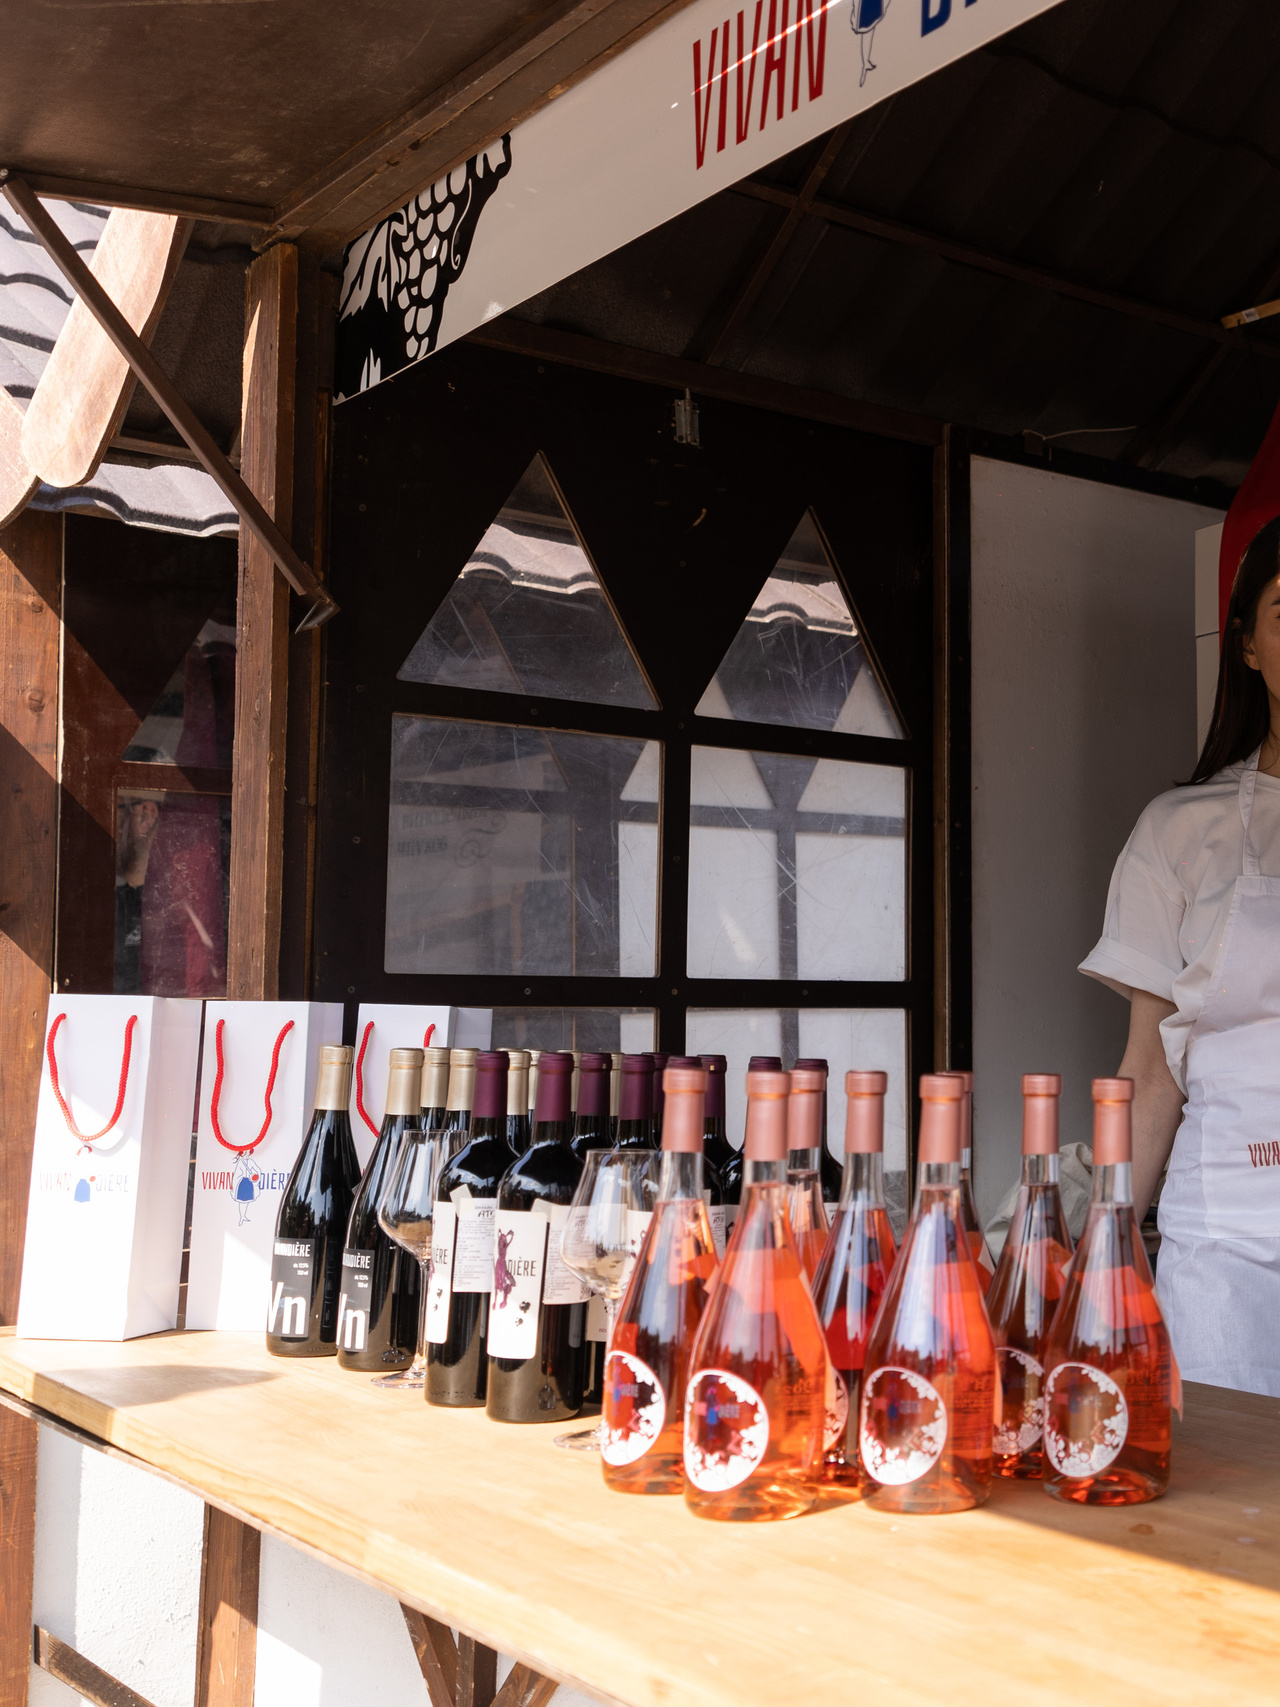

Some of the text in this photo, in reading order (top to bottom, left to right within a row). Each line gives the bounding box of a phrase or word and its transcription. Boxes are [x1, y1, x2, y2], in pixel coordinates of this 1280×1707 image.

[693, 0, 828, 171] VIVAN
[202, 1171, 234, 1190] VIVAN
[507, 1256, 537, 1277] DIÈRE
